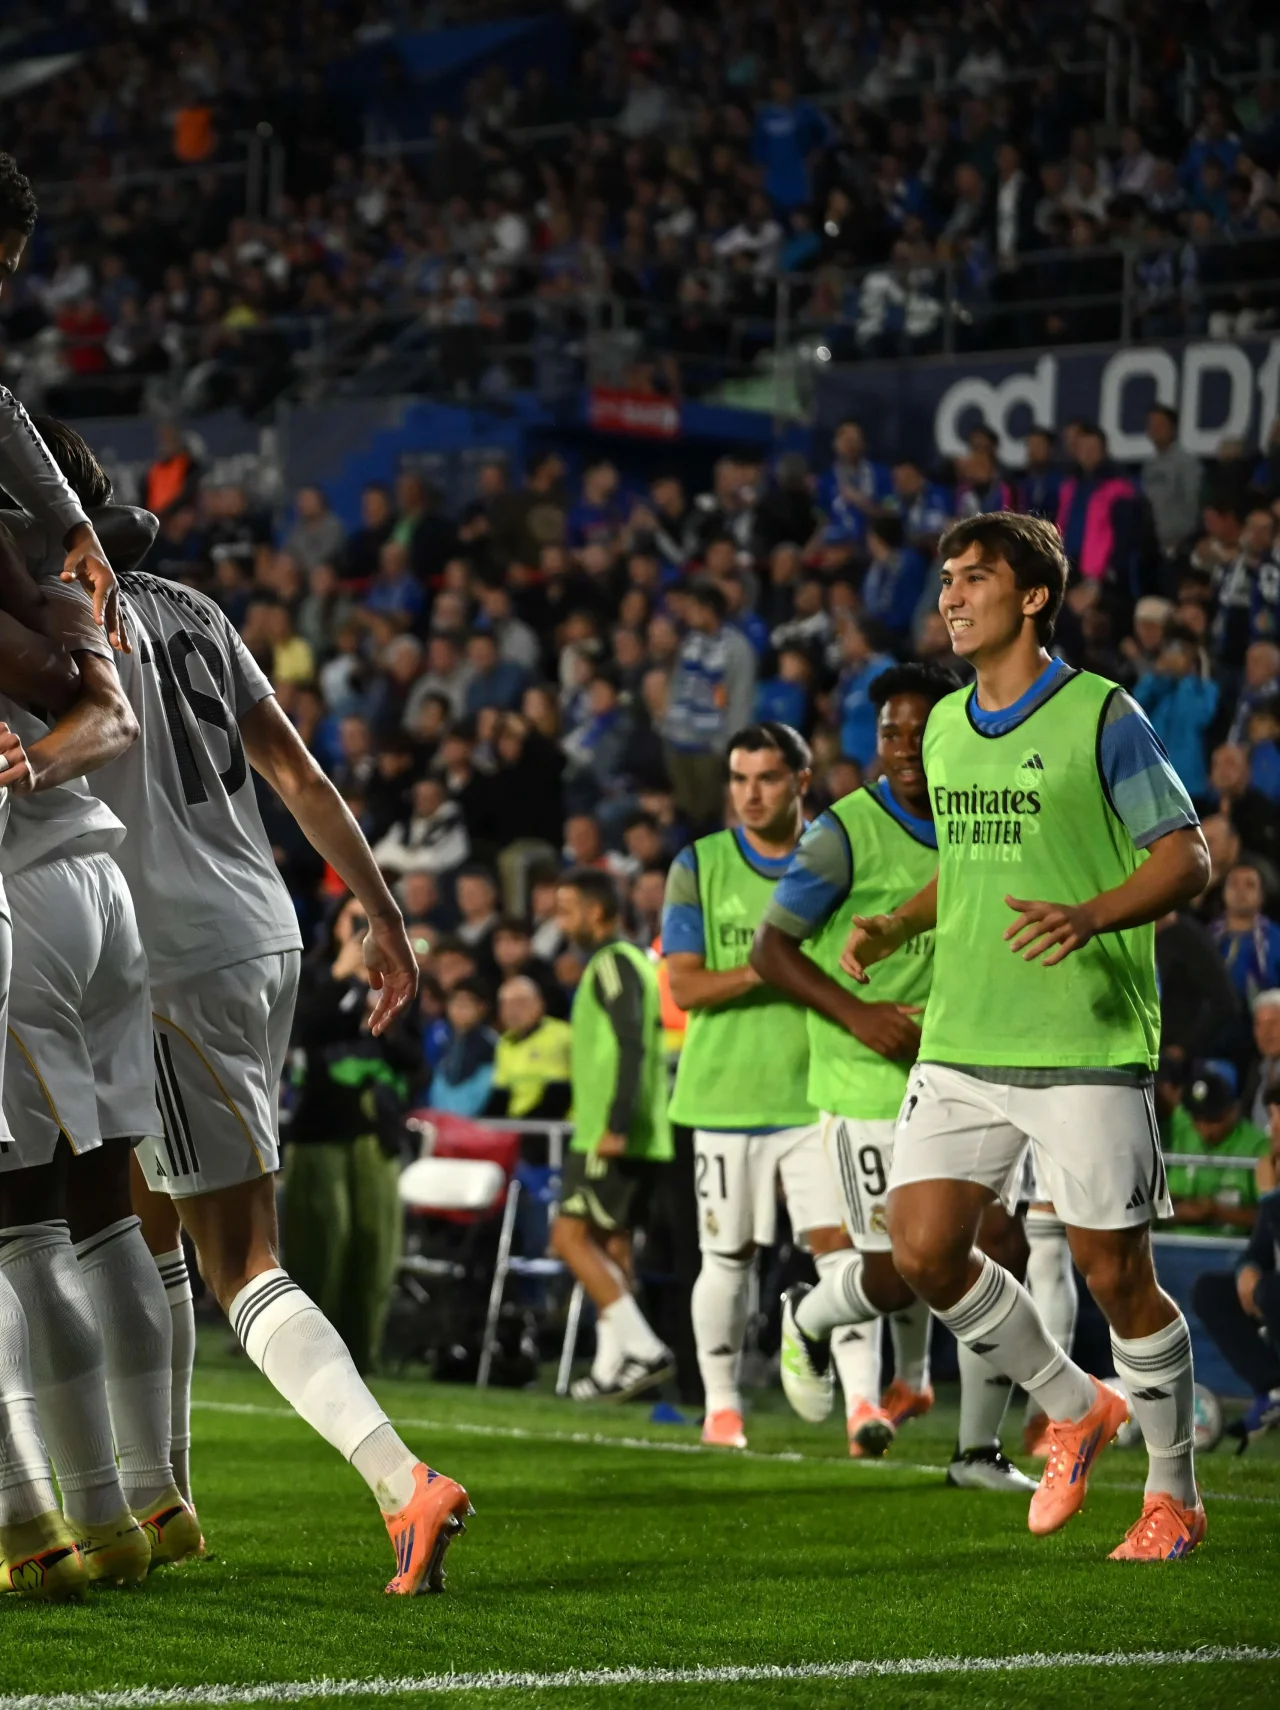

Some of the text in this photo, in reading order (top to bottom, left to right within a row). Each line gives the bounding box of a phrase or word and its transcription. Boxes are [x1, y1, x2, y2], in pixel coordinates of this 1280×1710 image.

[933, 783, 1041, 816] Emirates
[948, 820, 1022, 844] FLY BETTER
[695, 1152, 727, 1199] 21
[858, 1145, 887, 1196] 9
